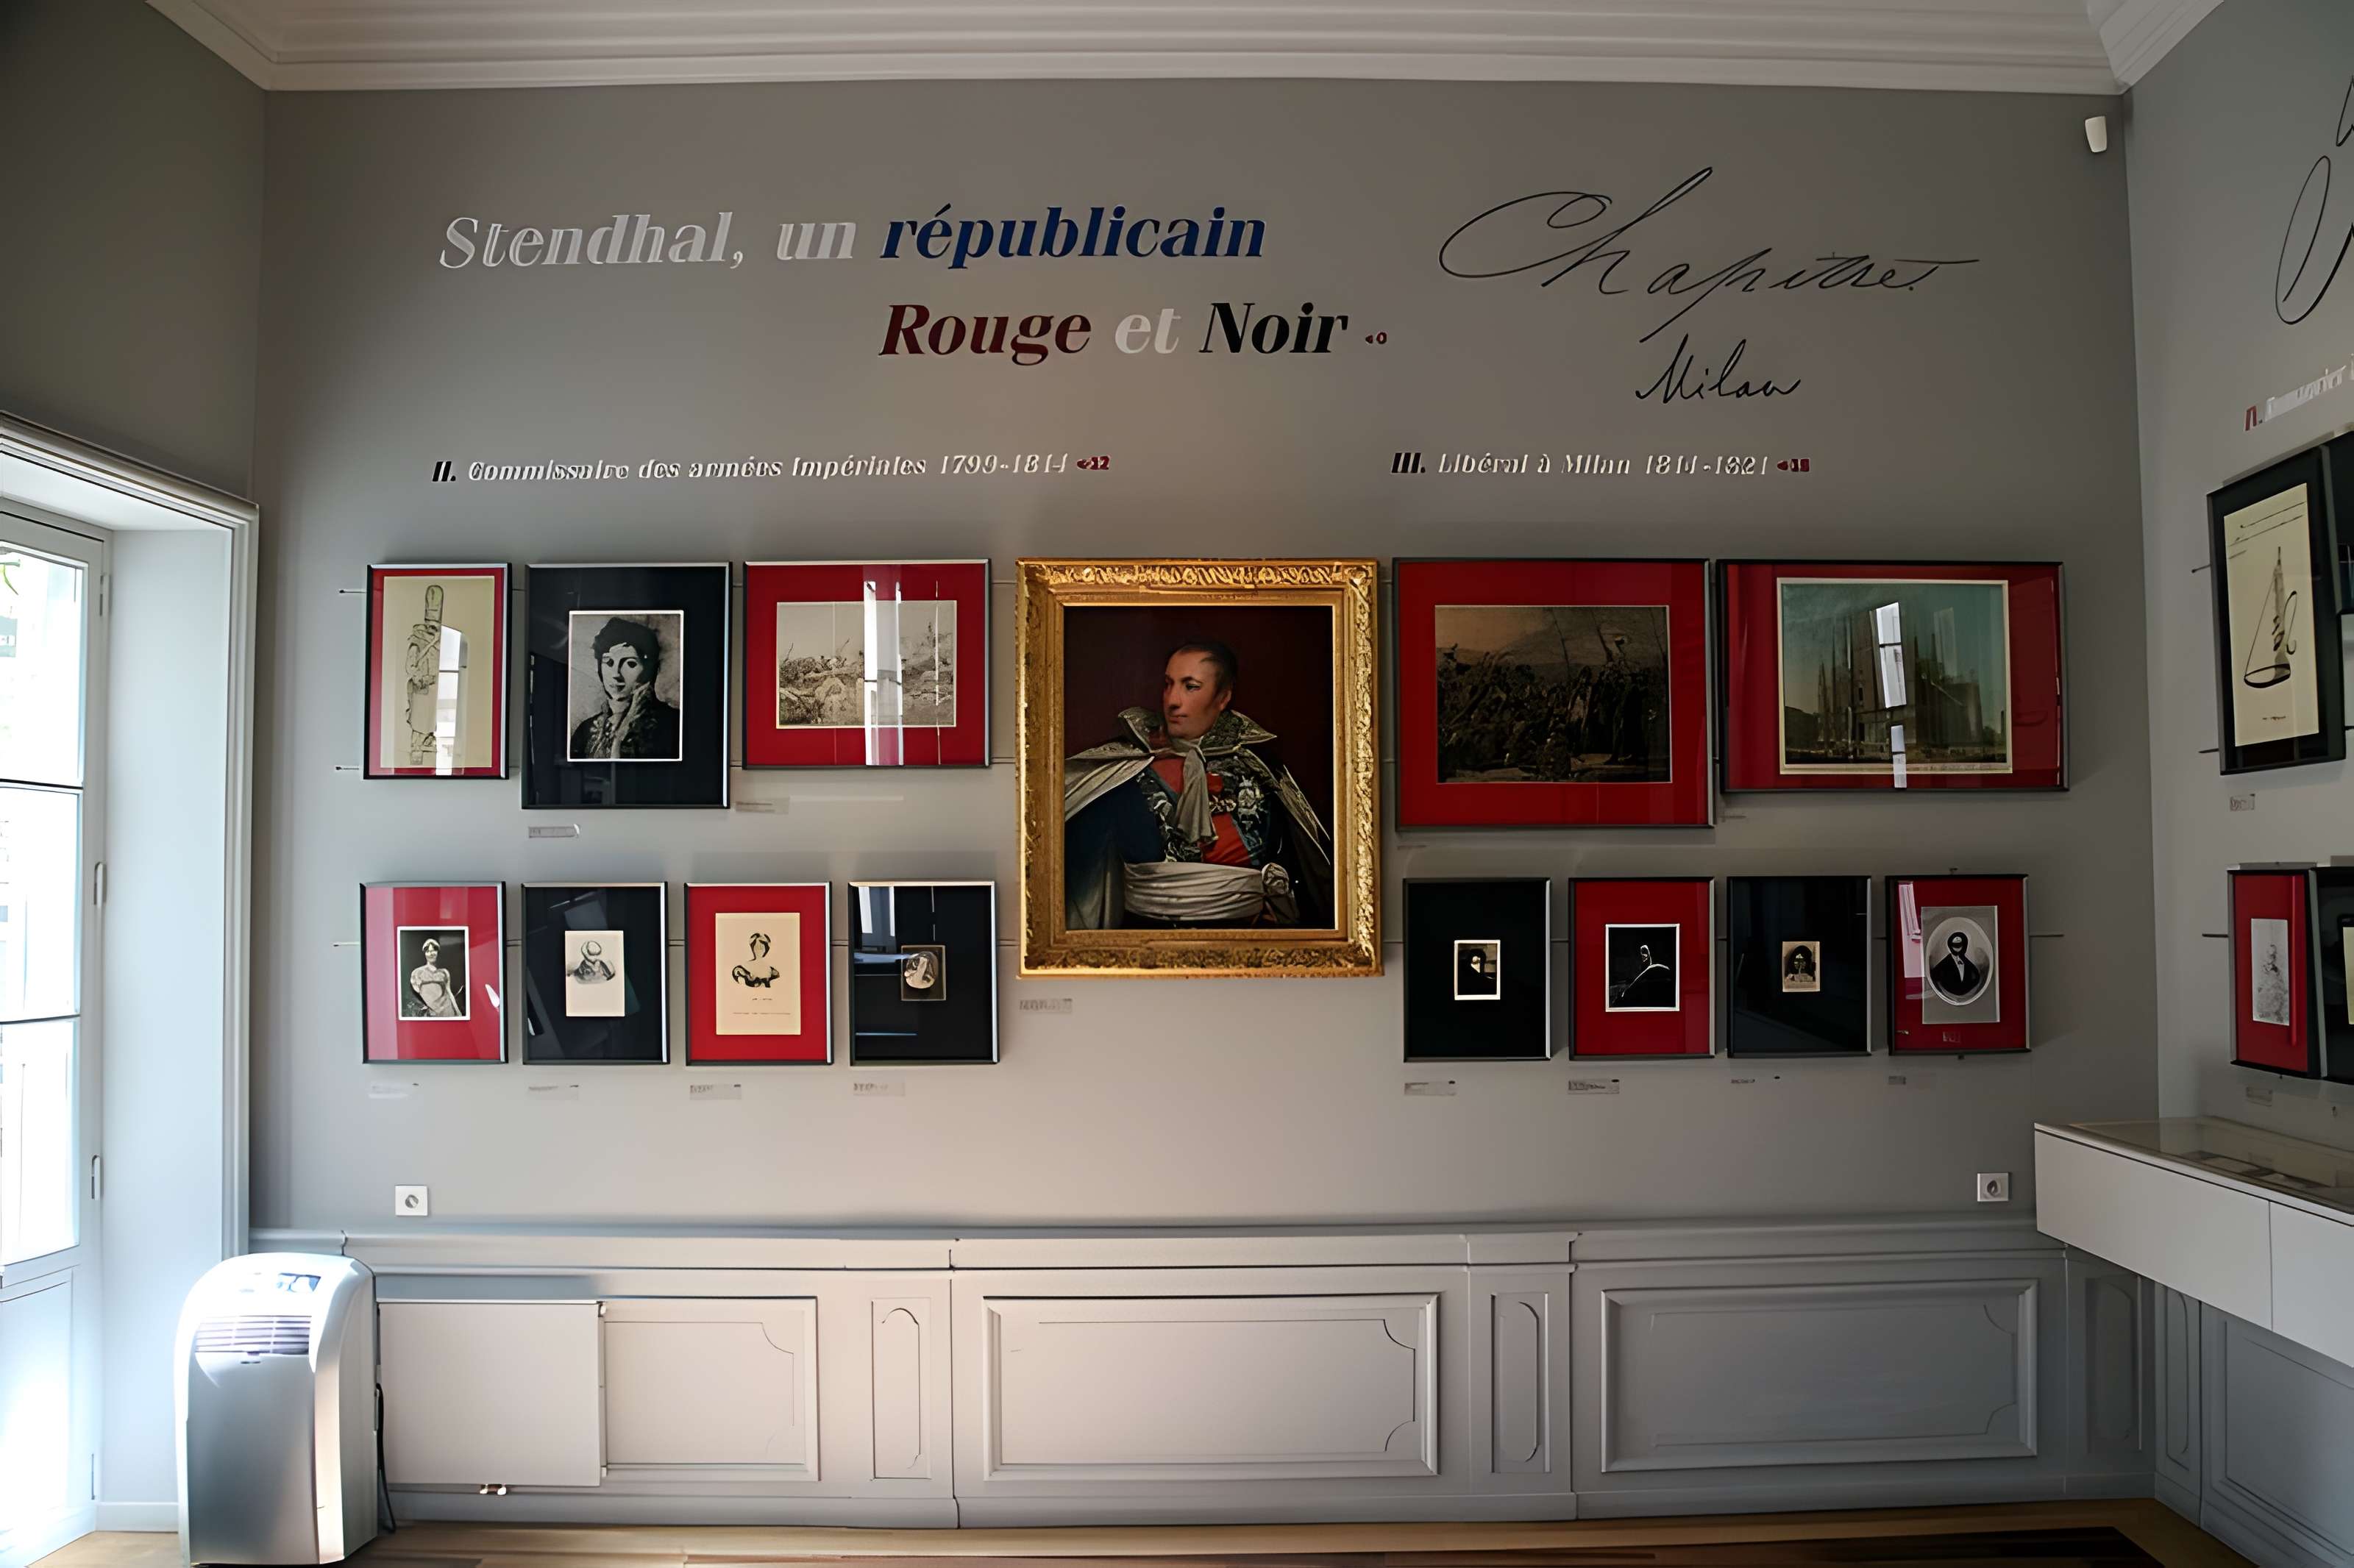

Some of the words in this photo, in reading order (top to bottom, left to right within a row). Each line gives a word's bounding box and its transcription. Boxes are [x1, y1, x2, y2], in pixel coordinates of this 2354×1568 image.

[439, 212, 744, 268] Stendhal,
[778, 222, 856, 260] un
[880, 203, 1266, 269] républicain
[878, 303, 1092, 366] Rouge
[1114, 308, 1181, 354] et
[1198, 302, 1348, 354] Noir
[1635, 334, 1800, 404] Milan
[432, 460, 457, 482] II.
[469, 460, 629, 481] Commissaire
[639, 459, 681, 479] des
[792, 455, 927, 480] Impériales
[1391, 452, 1426, 474] III.
[1438, 452, 1529, 473] Libéral
[1537, 453, 1551, 473] à
[1561, 455, 1630, 474] Milan
